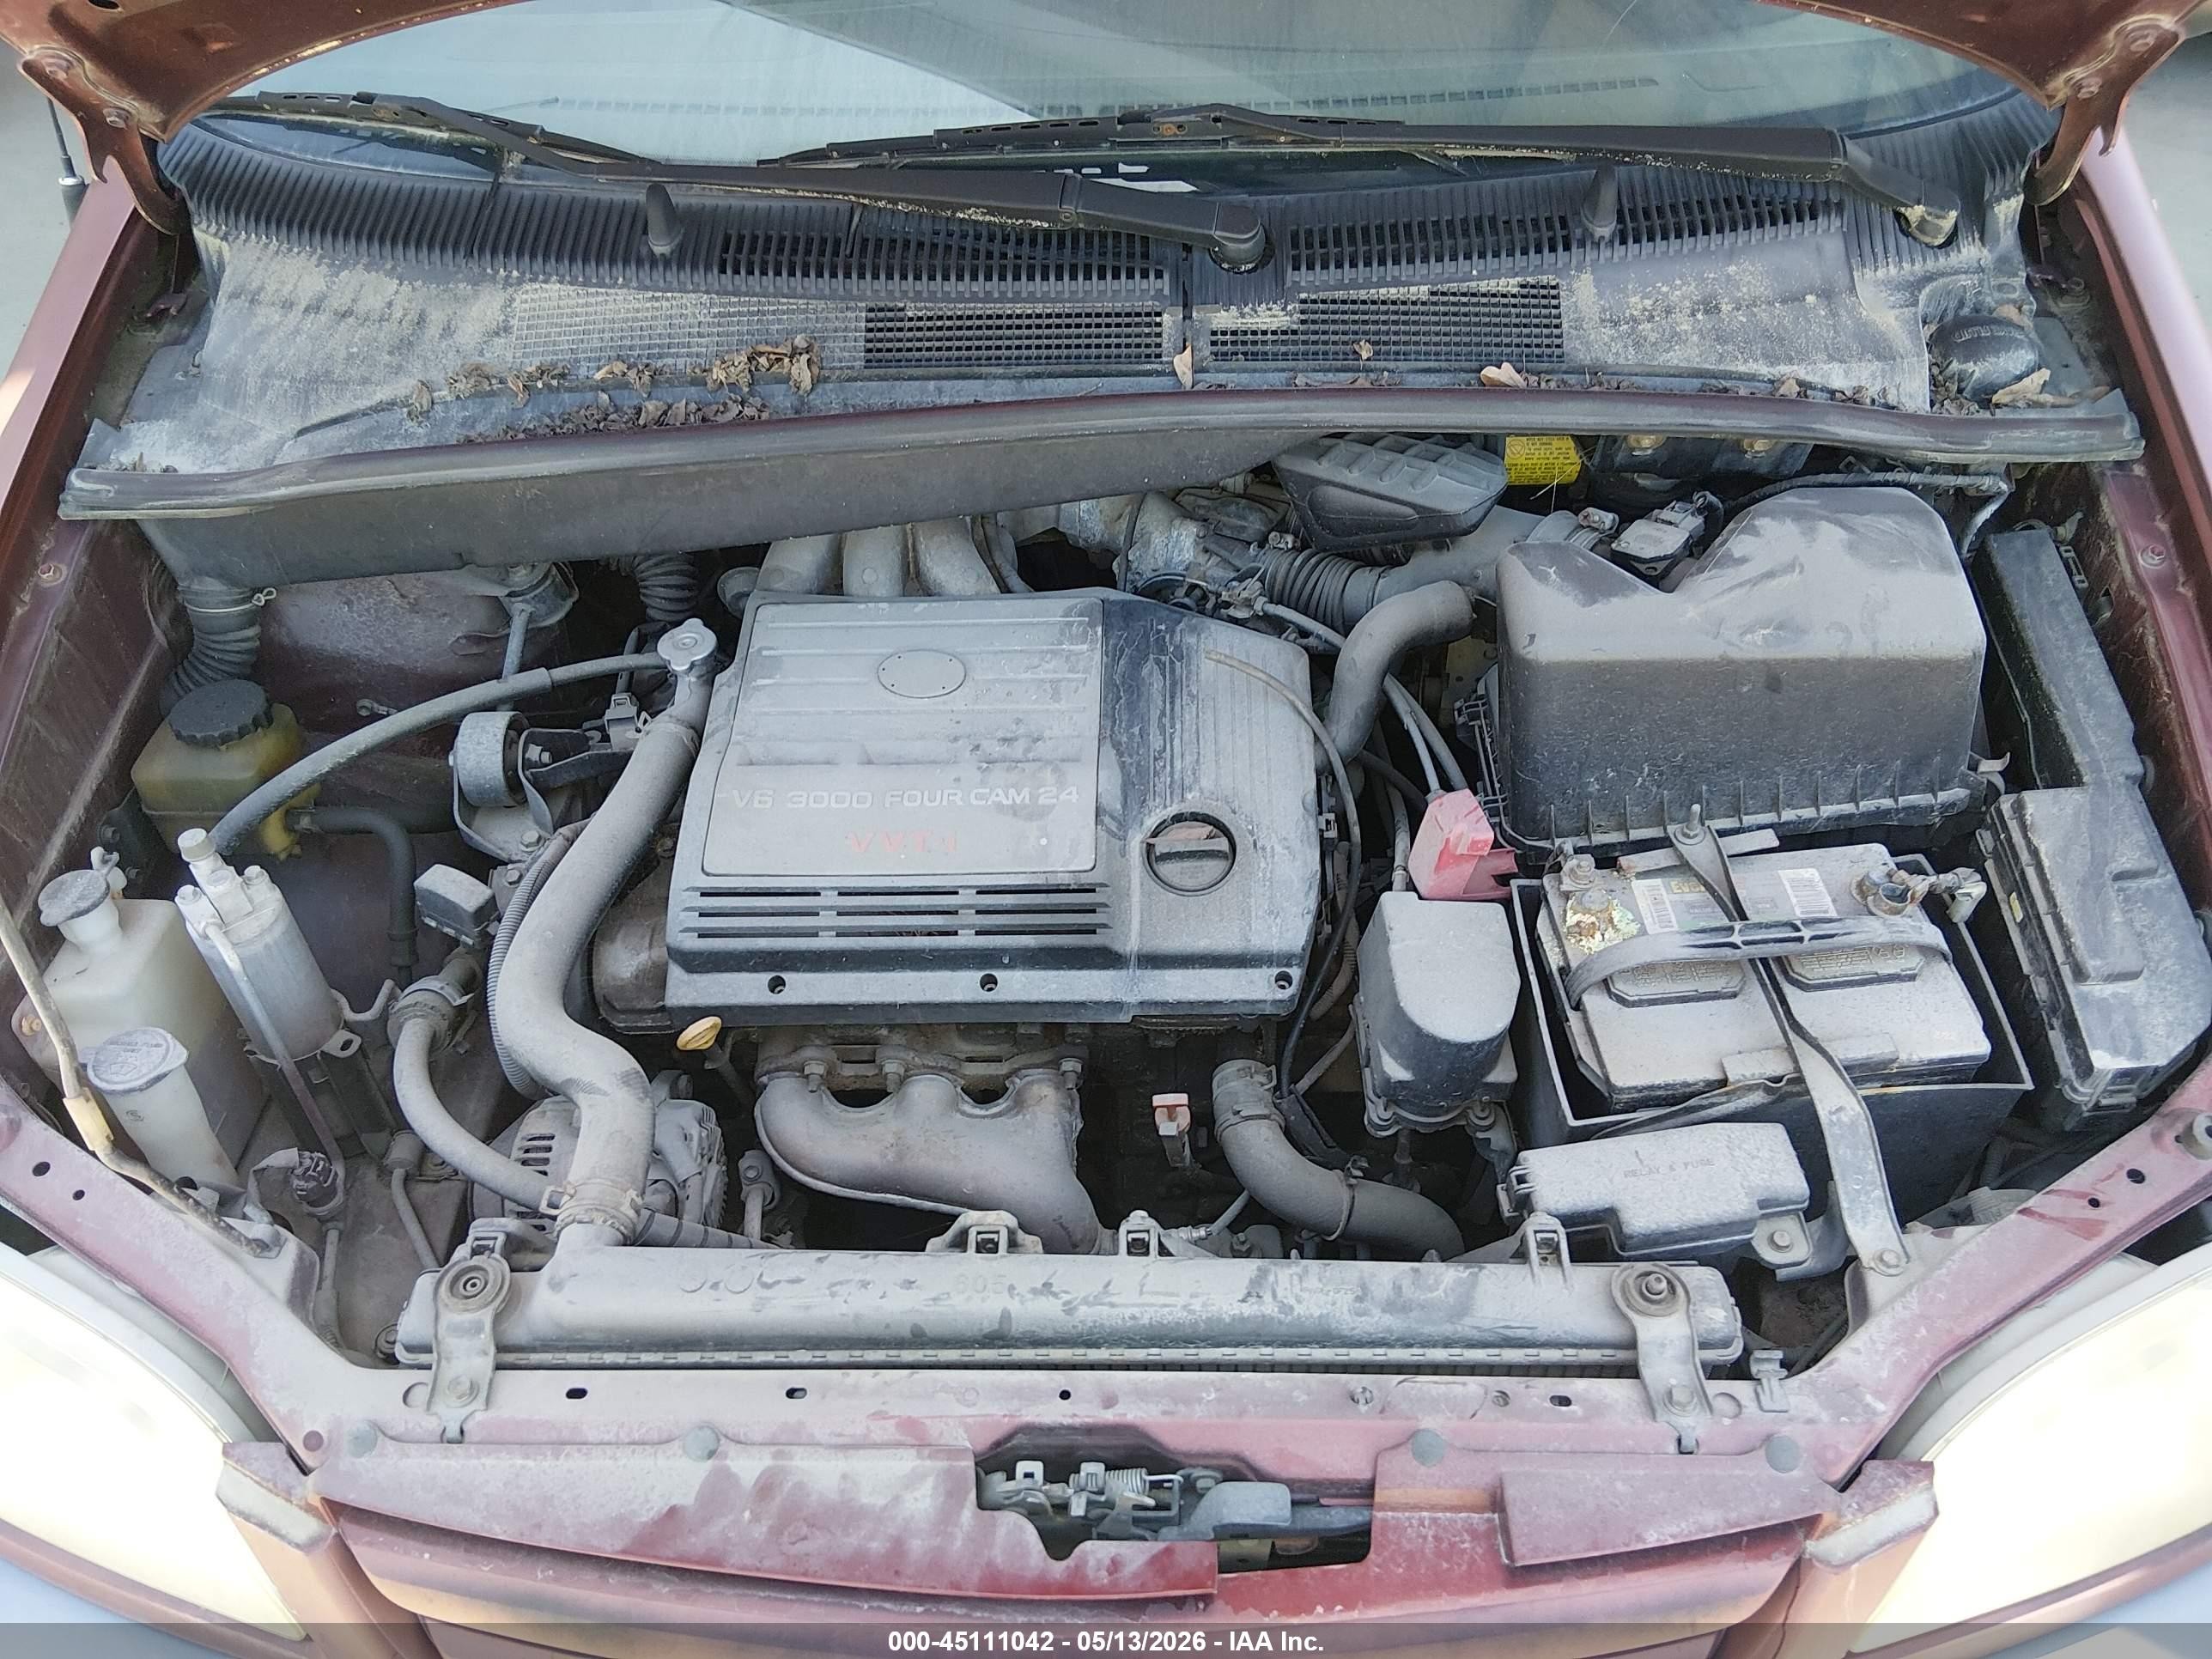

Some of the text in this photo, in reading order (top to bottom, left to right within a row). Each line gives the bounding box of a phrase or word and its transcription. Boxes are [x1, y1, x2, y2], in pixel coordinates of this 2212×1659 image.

[732, 786, 1079, 810] V6 3000 FOUR CAM 24
